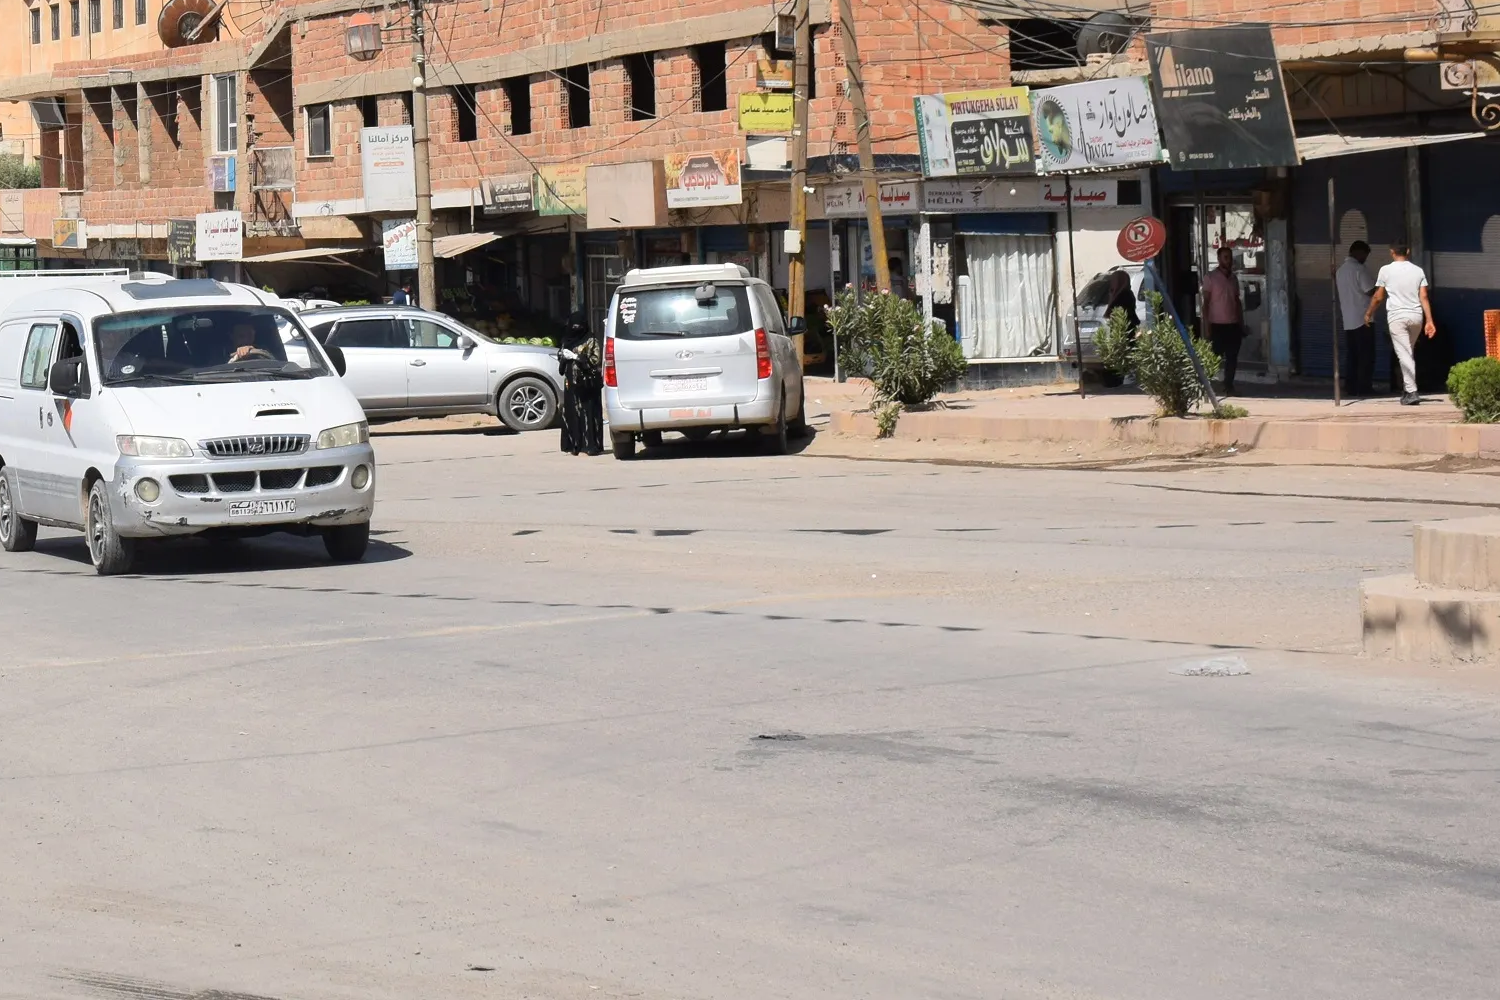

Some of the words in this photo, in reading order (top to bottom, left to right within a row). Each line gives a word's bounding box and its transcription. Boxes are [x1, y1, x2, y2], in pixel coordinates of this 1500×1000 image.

[1005, 120, 1025, 137] مكتبة
[391, 134, 409, 144] مركز
[1044, 184, 1107, 206] صيدية
